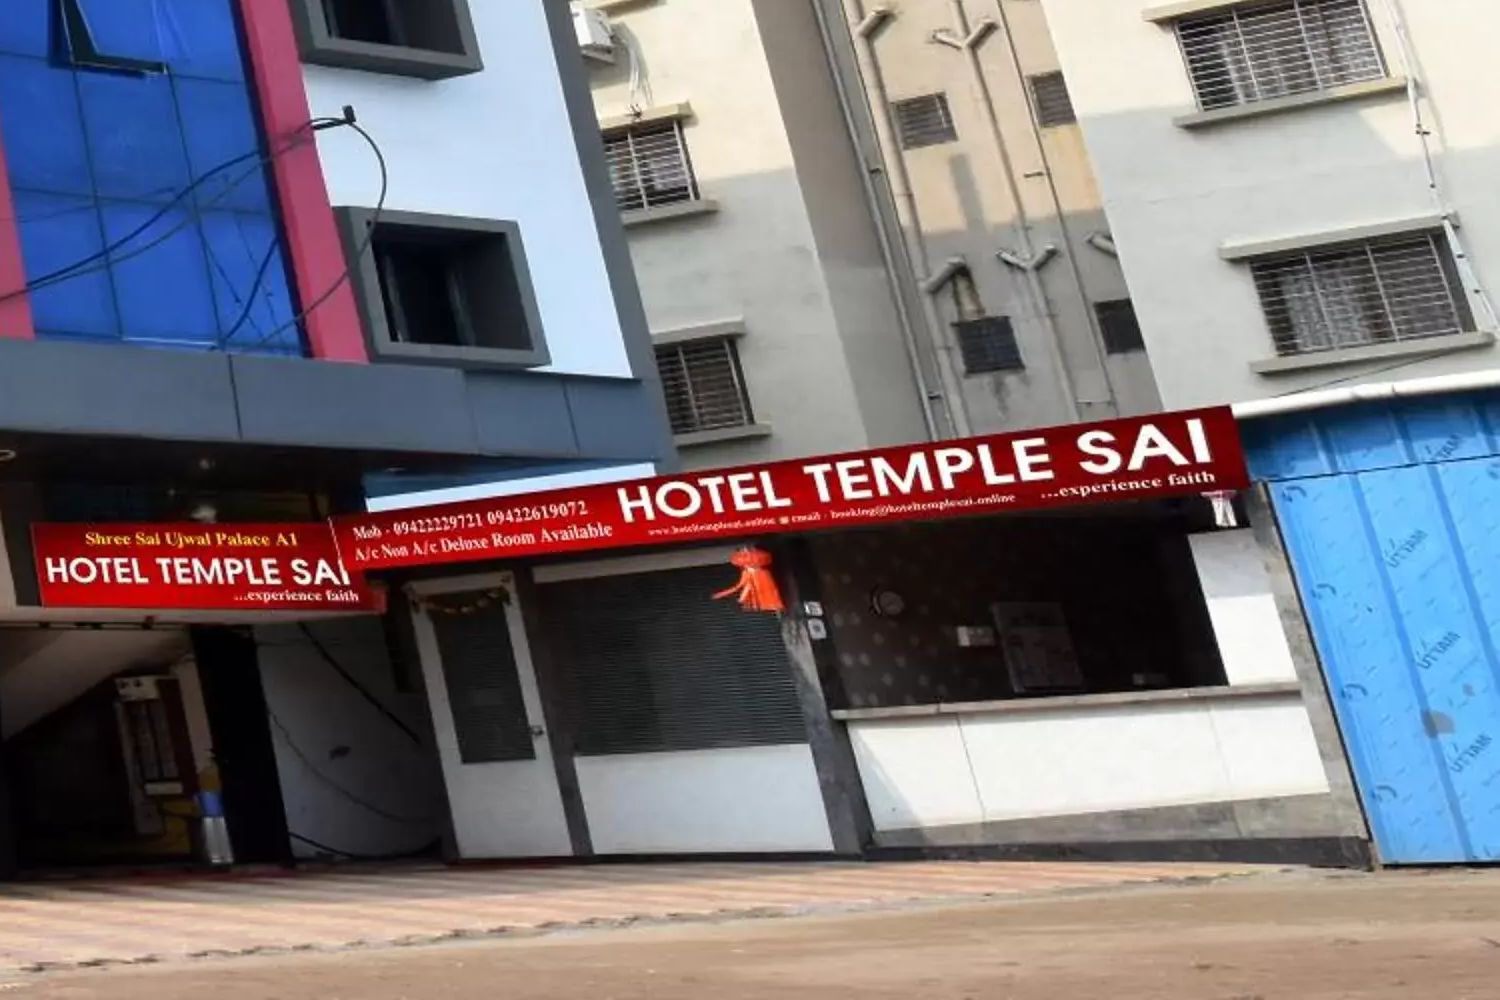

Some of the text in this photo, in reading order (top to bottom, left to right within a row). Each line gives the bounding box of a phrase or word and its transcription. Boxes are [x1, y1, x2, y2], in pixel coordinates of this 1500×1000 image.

[617, 418, 1214, 524] HOTEL TEMPLE SAI
[1040, 471, 1216, 499] ...experience faith
[353, 525, 382, 541] Mob
[487, 500, 588, 525] 09422619072
[85, 532, 298, 548] Shree Sai Ujwal Palace A1
[355, 522, 613, 561] A/c Non A/c Deluxe Room Available
[45, 557, 351, 585] HOTEL TEMPLE SAI
[234, 589, 359, 602] ...experience faith
